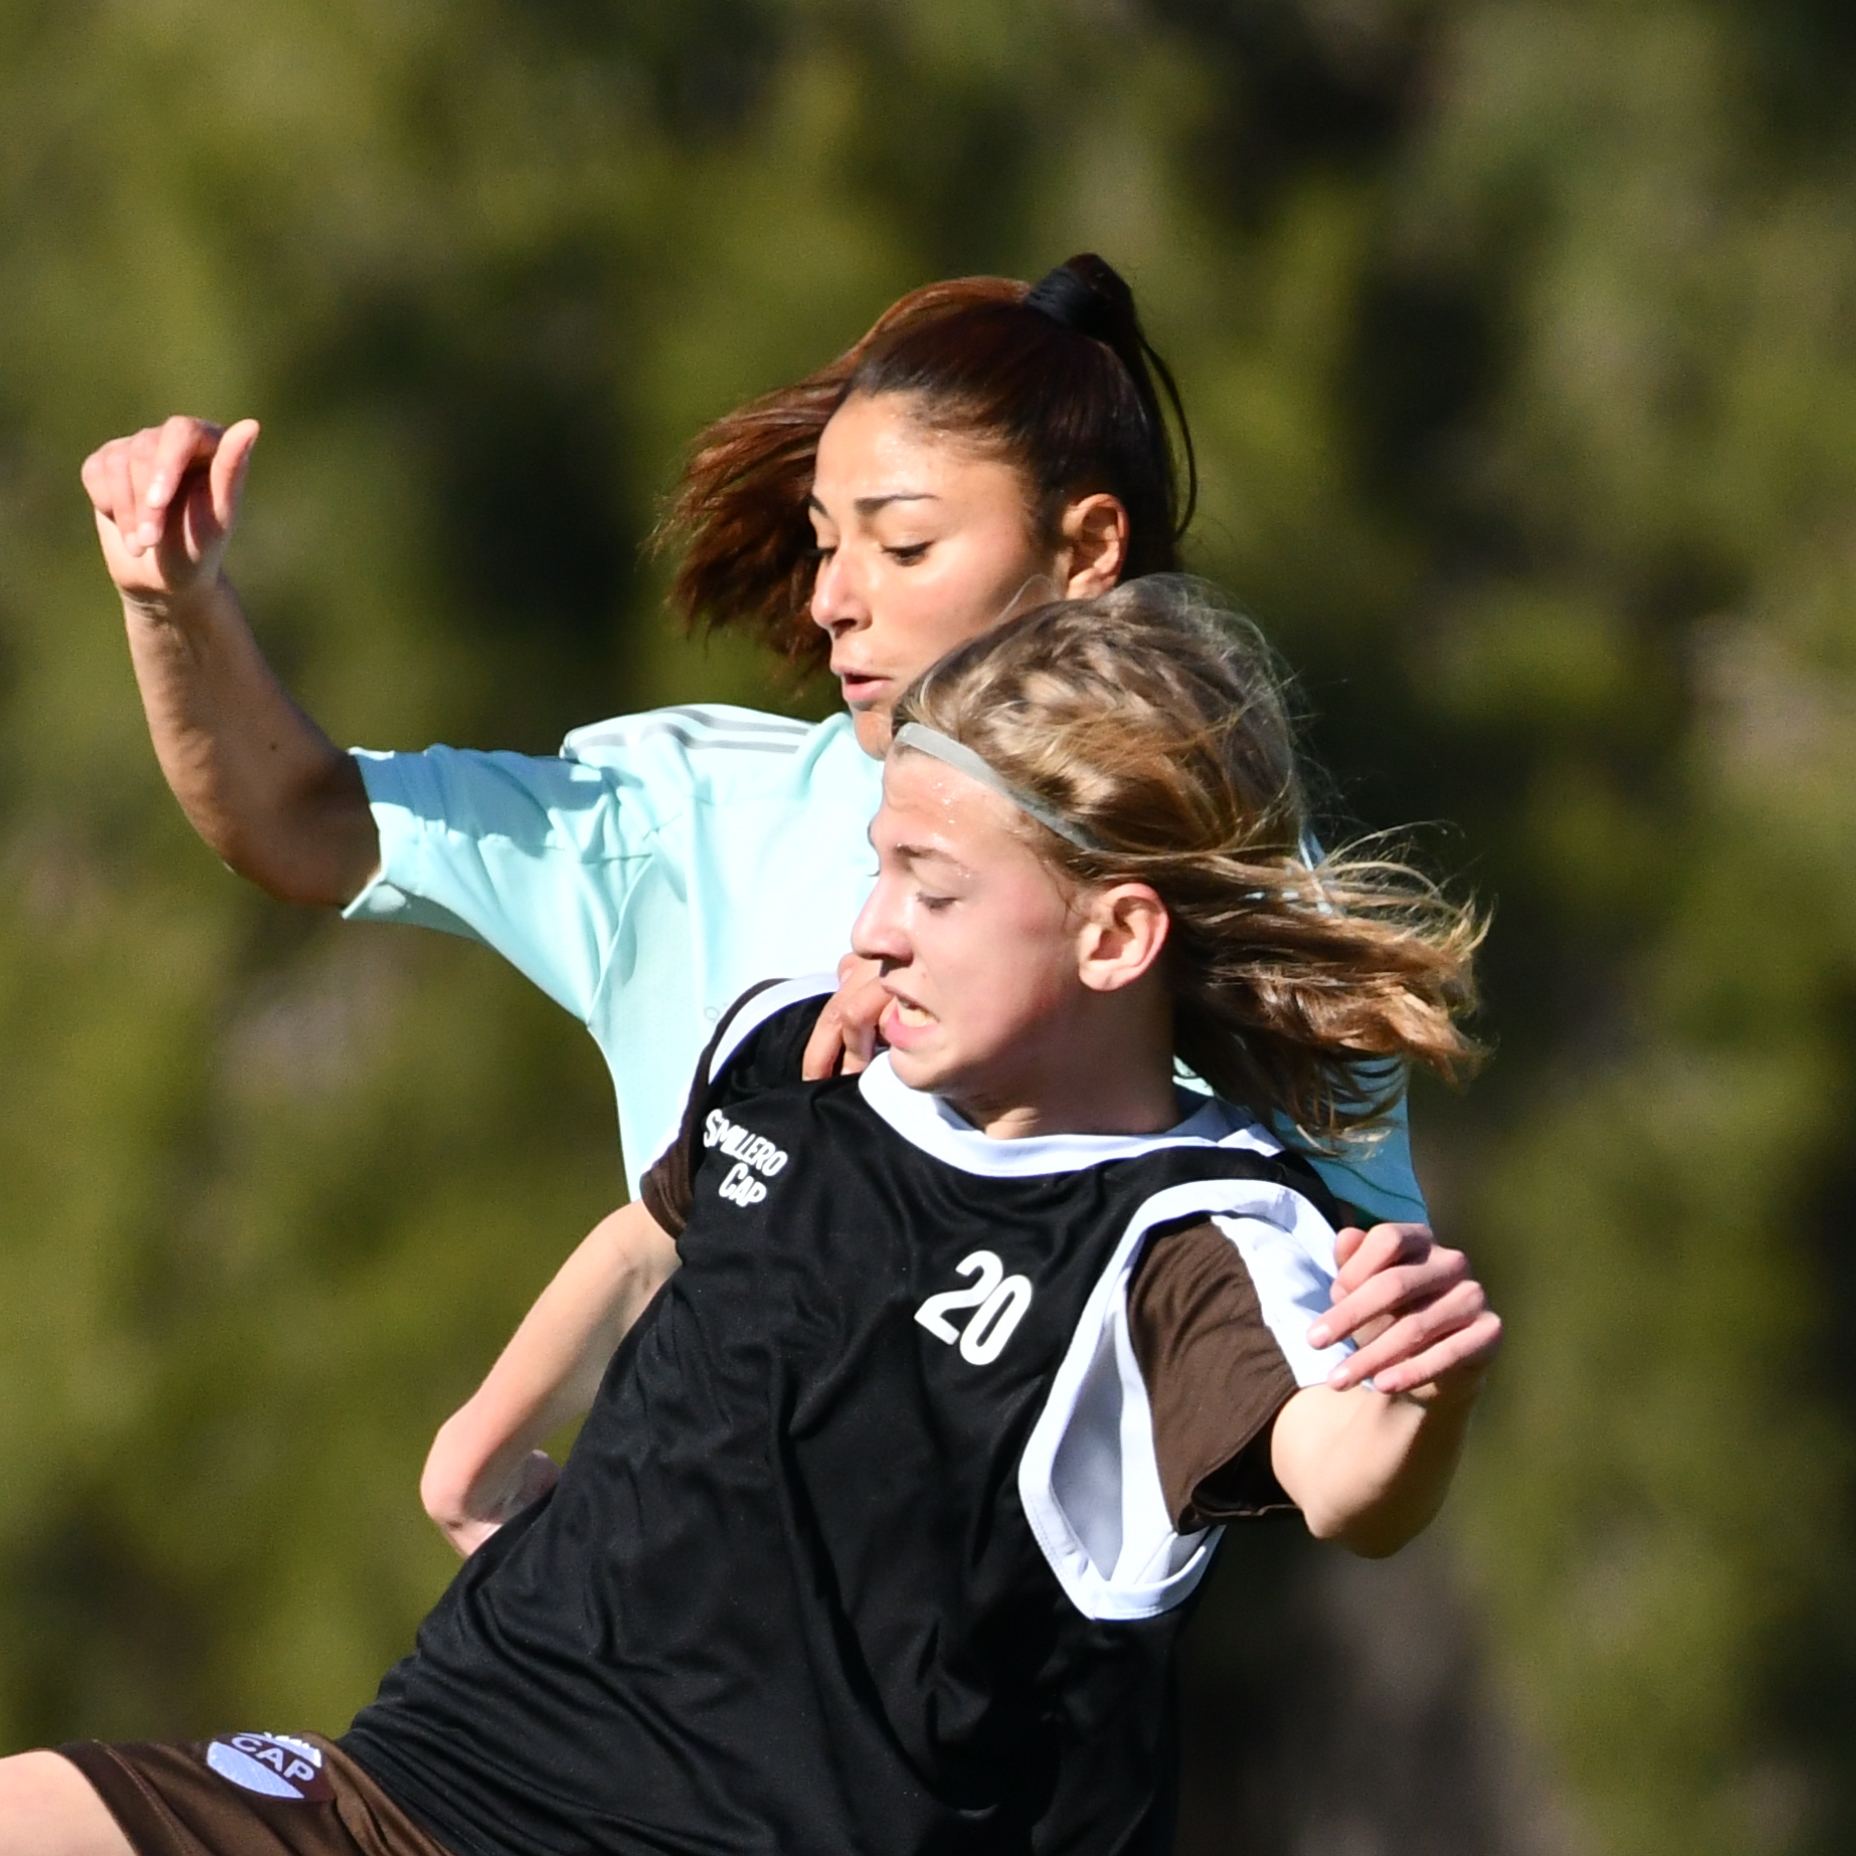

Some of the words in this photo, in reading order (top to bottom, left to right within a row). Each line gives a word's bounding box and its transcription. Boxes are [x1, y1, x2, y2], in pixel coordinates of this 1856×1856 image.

[703, 1108, 788, 1176] SMILLERO
[718, 1162, 767, 1207] CAP
[913, 1249, 1032, 1365] 20
[230, 1736, 315, 1781] CAP
